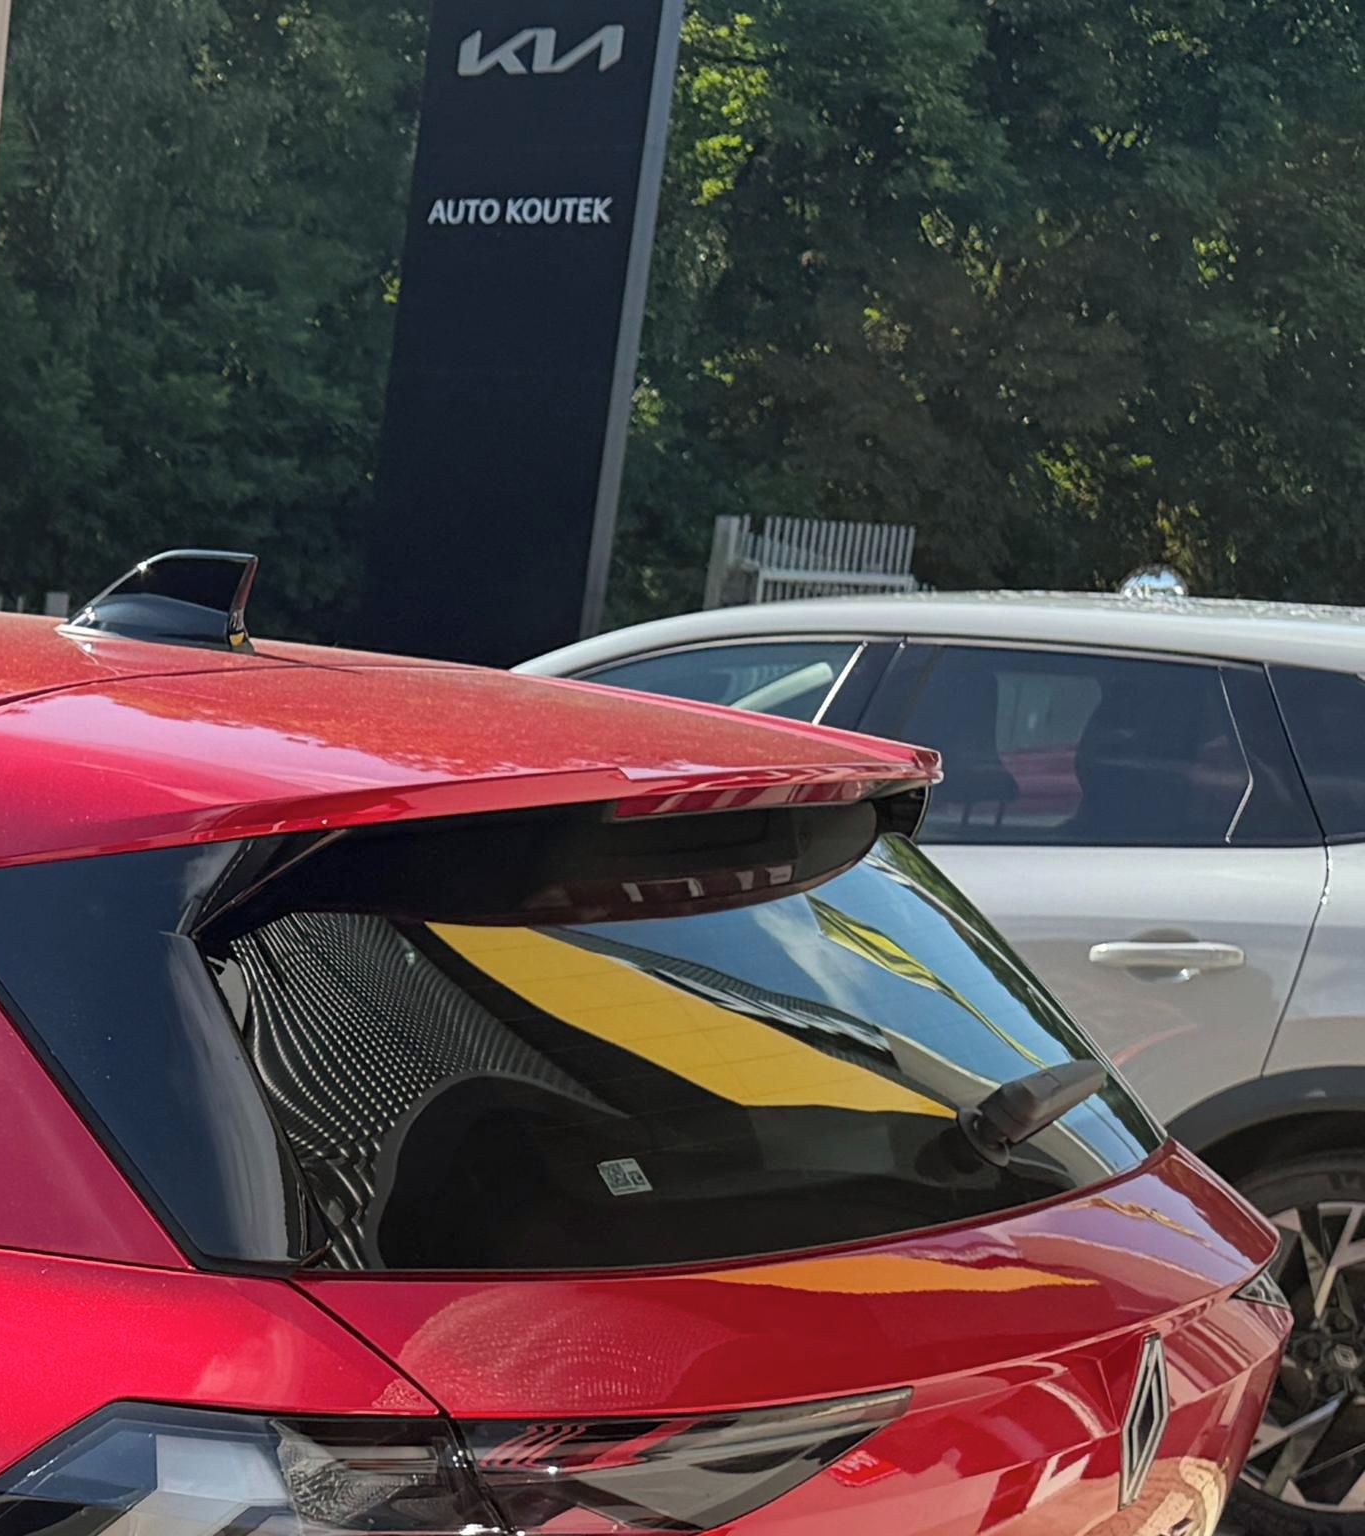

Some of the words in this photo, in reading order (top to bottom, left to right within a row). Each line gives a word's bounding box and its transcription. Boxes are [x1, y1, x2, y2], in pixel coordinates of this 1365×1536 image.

[456, 24, 625, 77] KIA
[426, 198, 502, 225] AUTO
[504, 196, 613, 225] KOUTEK
